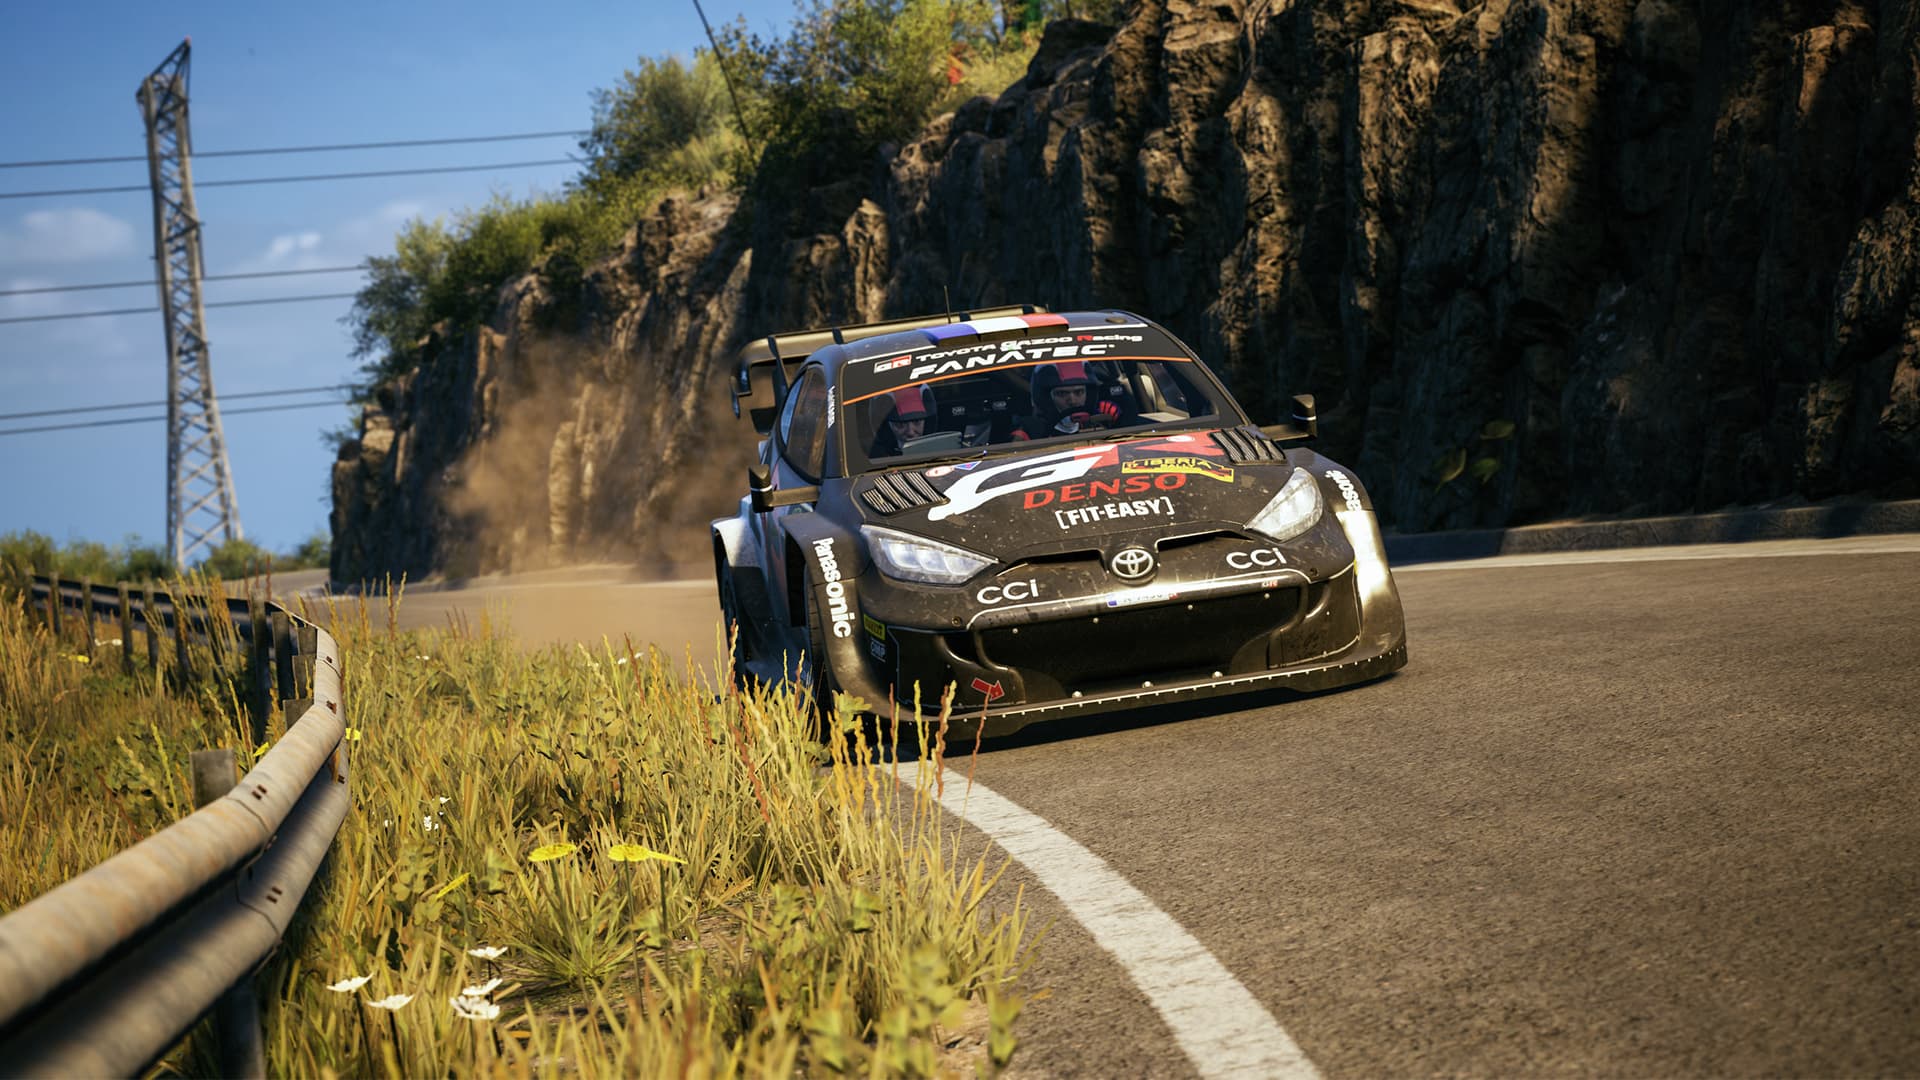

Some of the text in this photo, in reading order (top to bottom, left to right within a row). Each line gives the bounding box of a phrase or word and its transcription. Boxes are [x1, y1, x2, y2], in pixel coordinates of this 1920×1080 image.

[909, 345, 1108, 380] FANATEC
[916, 334, 1143, 361] TOYOTA GAZOO Racing
[874, 355, 912, 373] GR
[1143, 457, 1211, 469] IBERIA
[1023, 473, 1187, 509] DENSO
[812, 537, 856, 638] Panasonic
